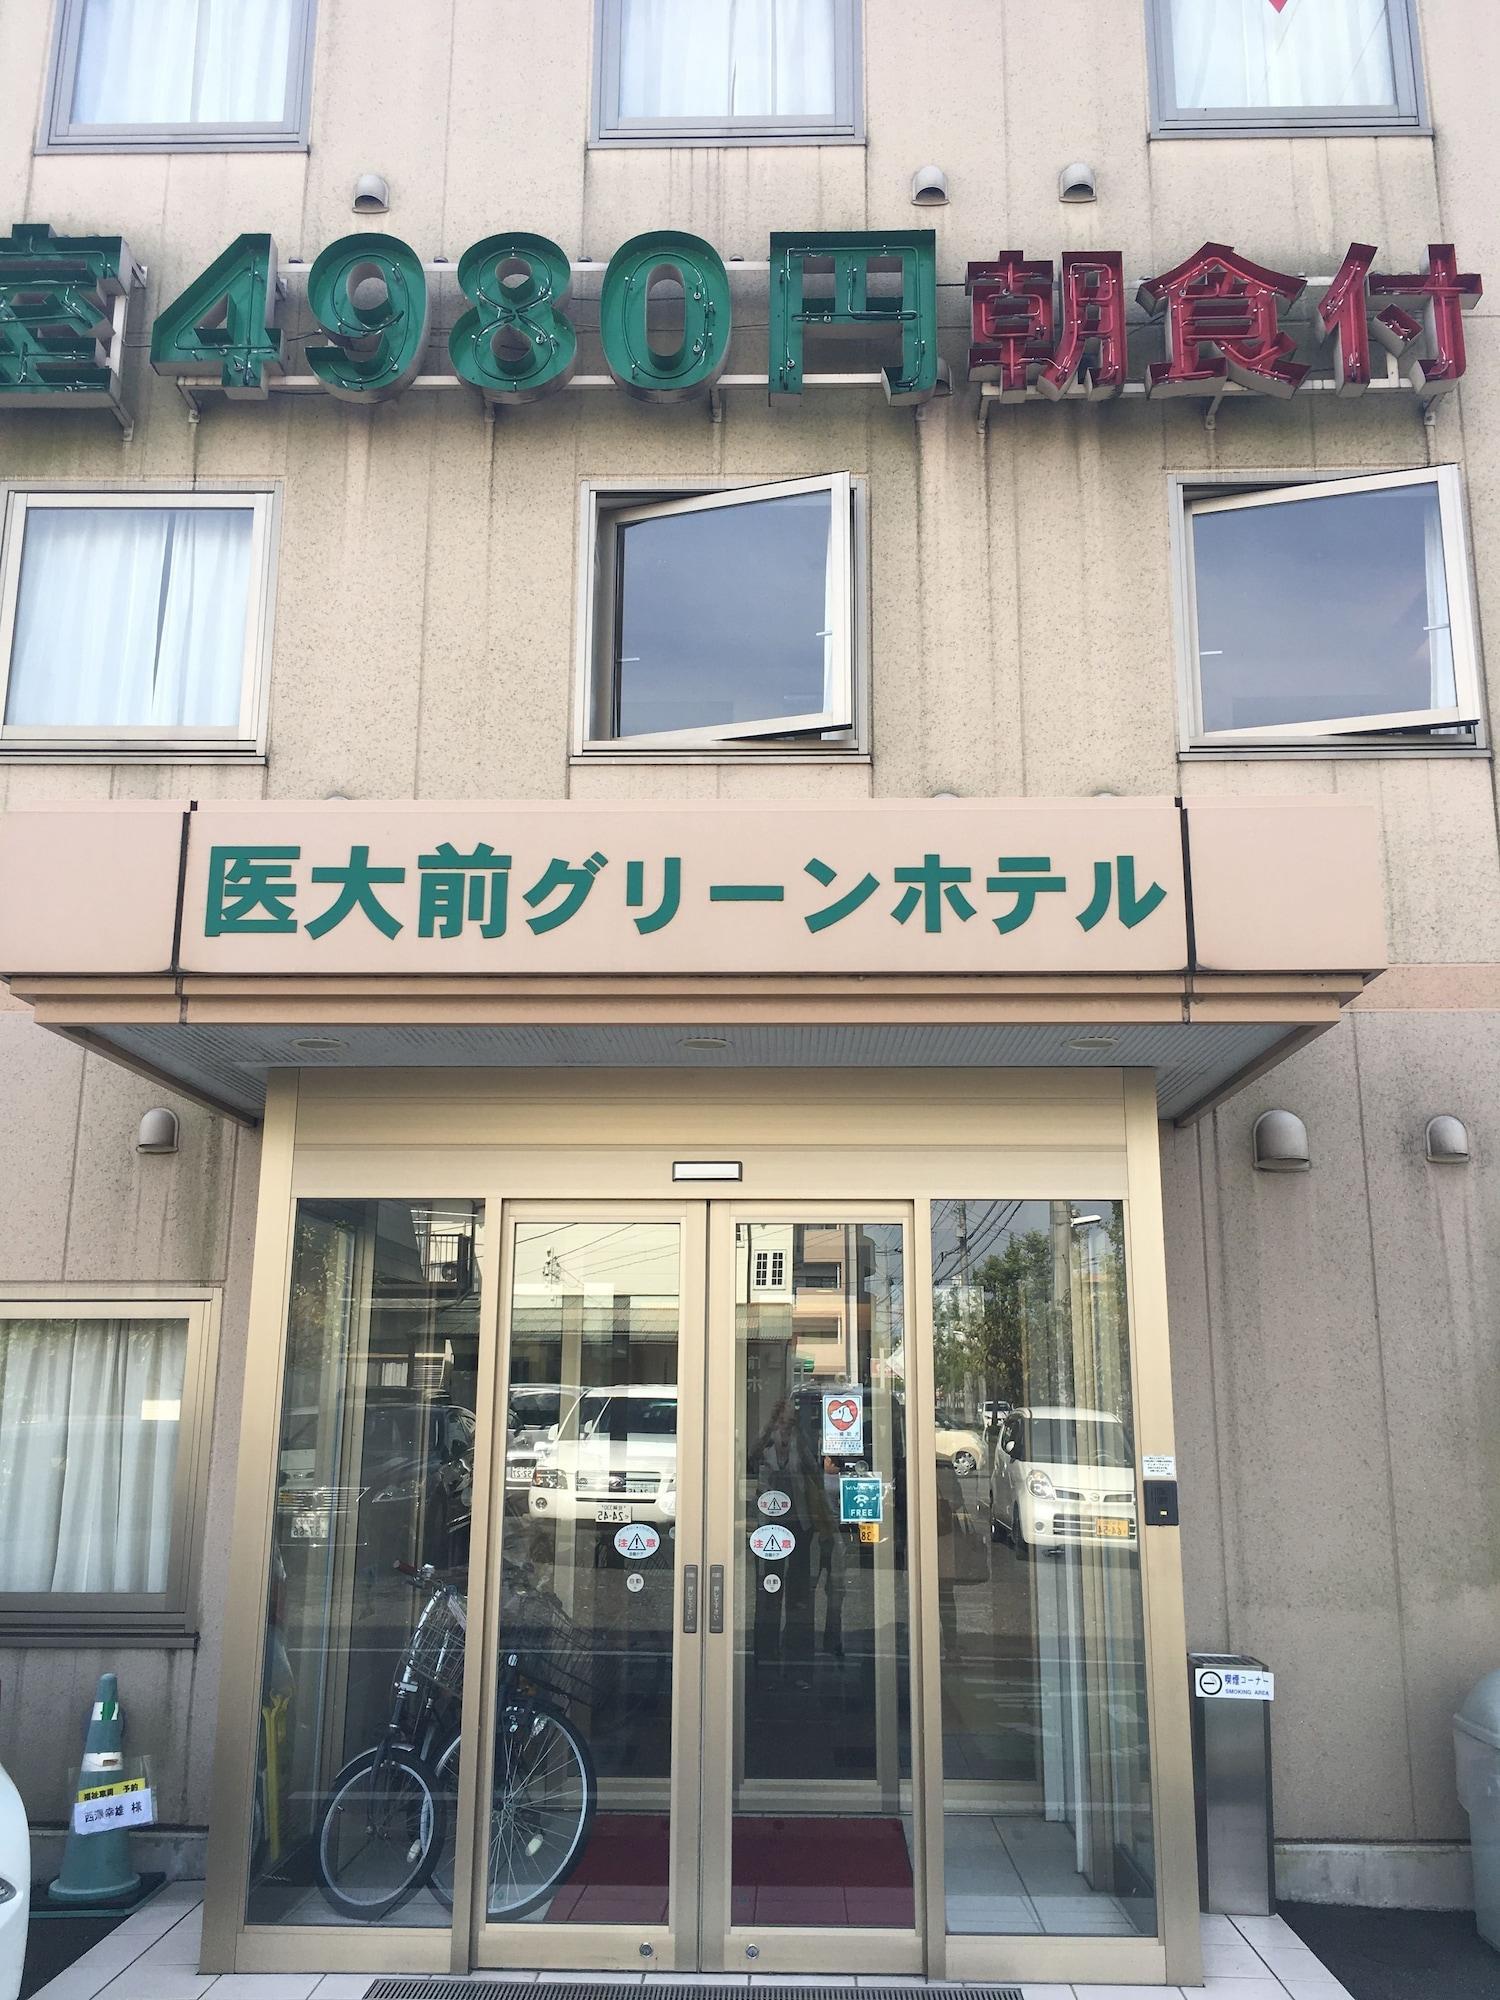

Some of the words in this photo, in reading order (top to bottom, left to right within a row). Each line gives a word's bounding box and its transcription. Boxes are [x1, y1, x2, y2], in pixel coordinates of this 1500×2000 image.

[205, 842, 1167, 941] 医大前グリーンホテル
[850, 1509, 873, 1517] FREE
[1224, 1674, 1269, 1686] 喫煙コーナー
